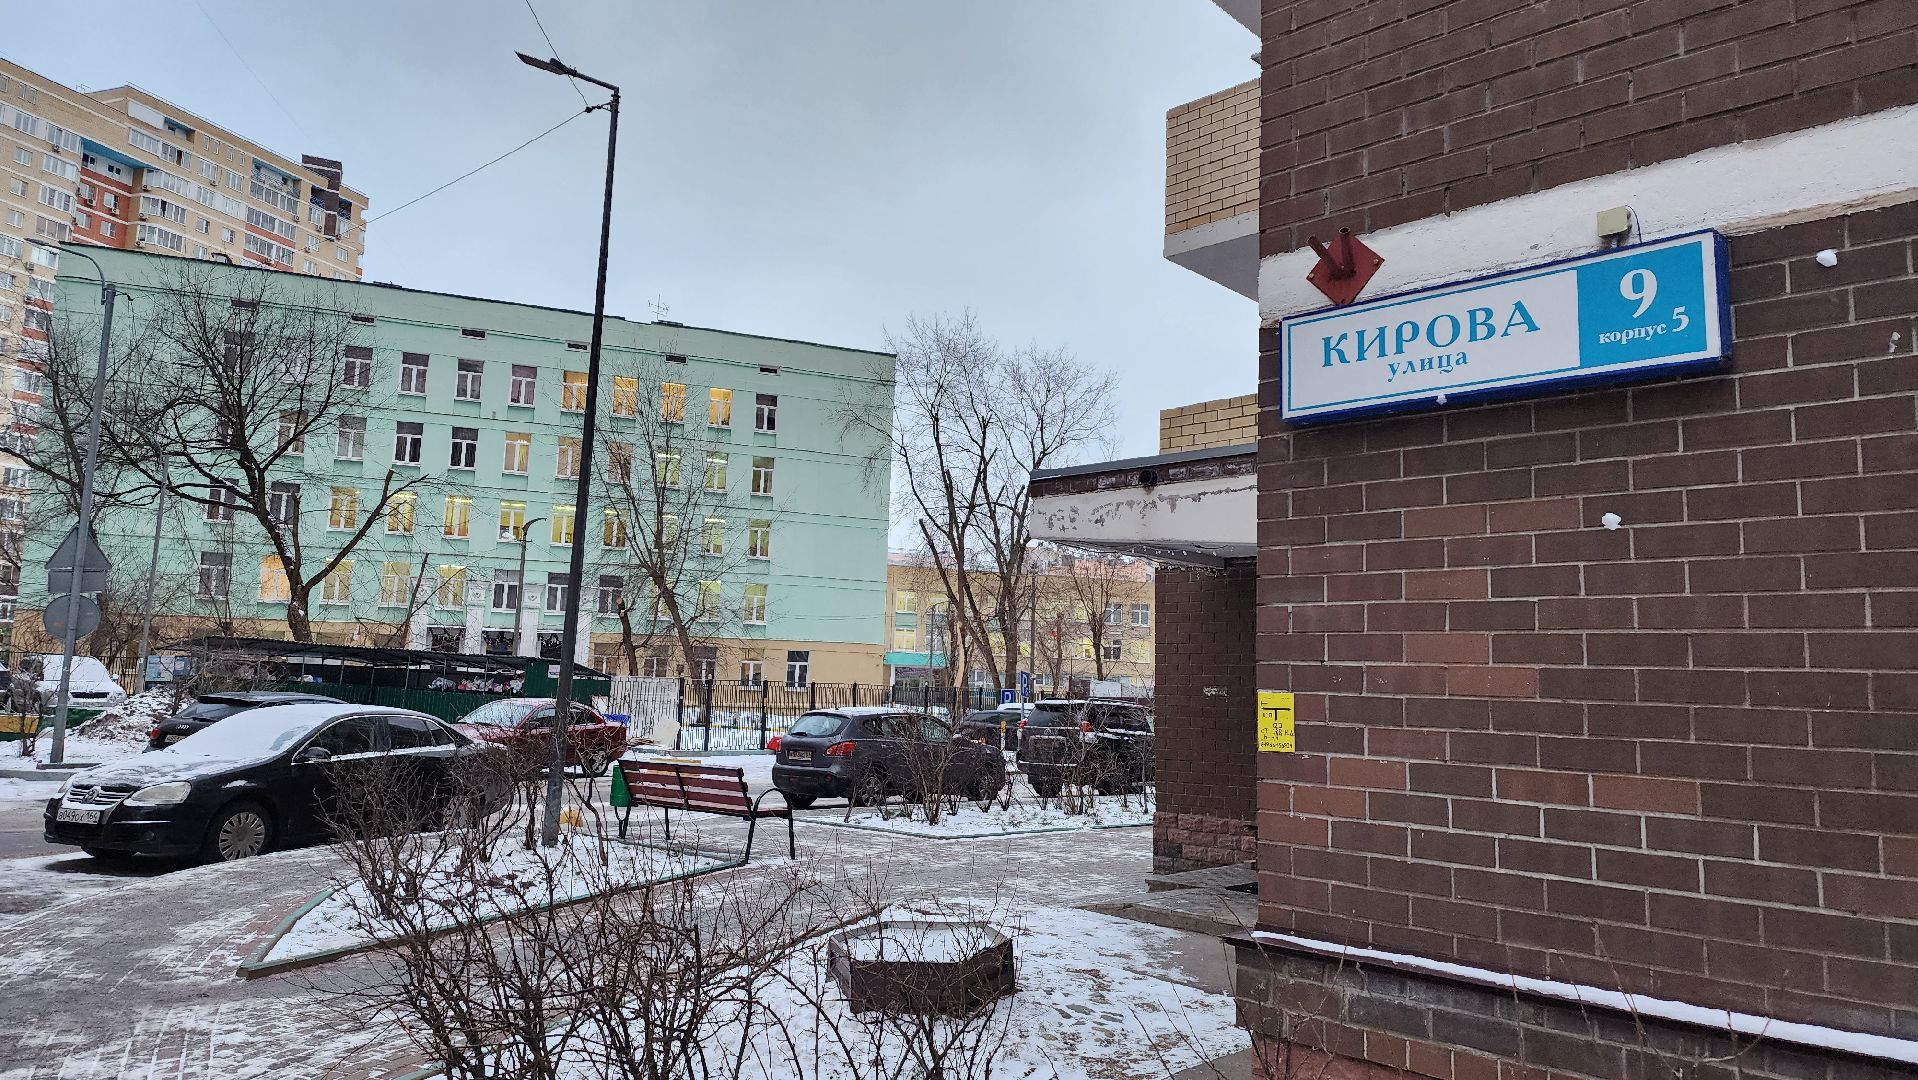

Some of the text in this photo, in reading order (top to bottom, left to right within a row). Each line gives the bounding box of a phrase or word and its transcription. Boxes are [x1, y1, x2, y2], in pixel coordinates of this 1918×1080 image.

[1619, 268, 1658, 319] 9
[1321, 299, 1541, 368] КИРОВА
[1599, 306, 1690, 345] корпус 5
[1387, 351, 1469, 383] улица
